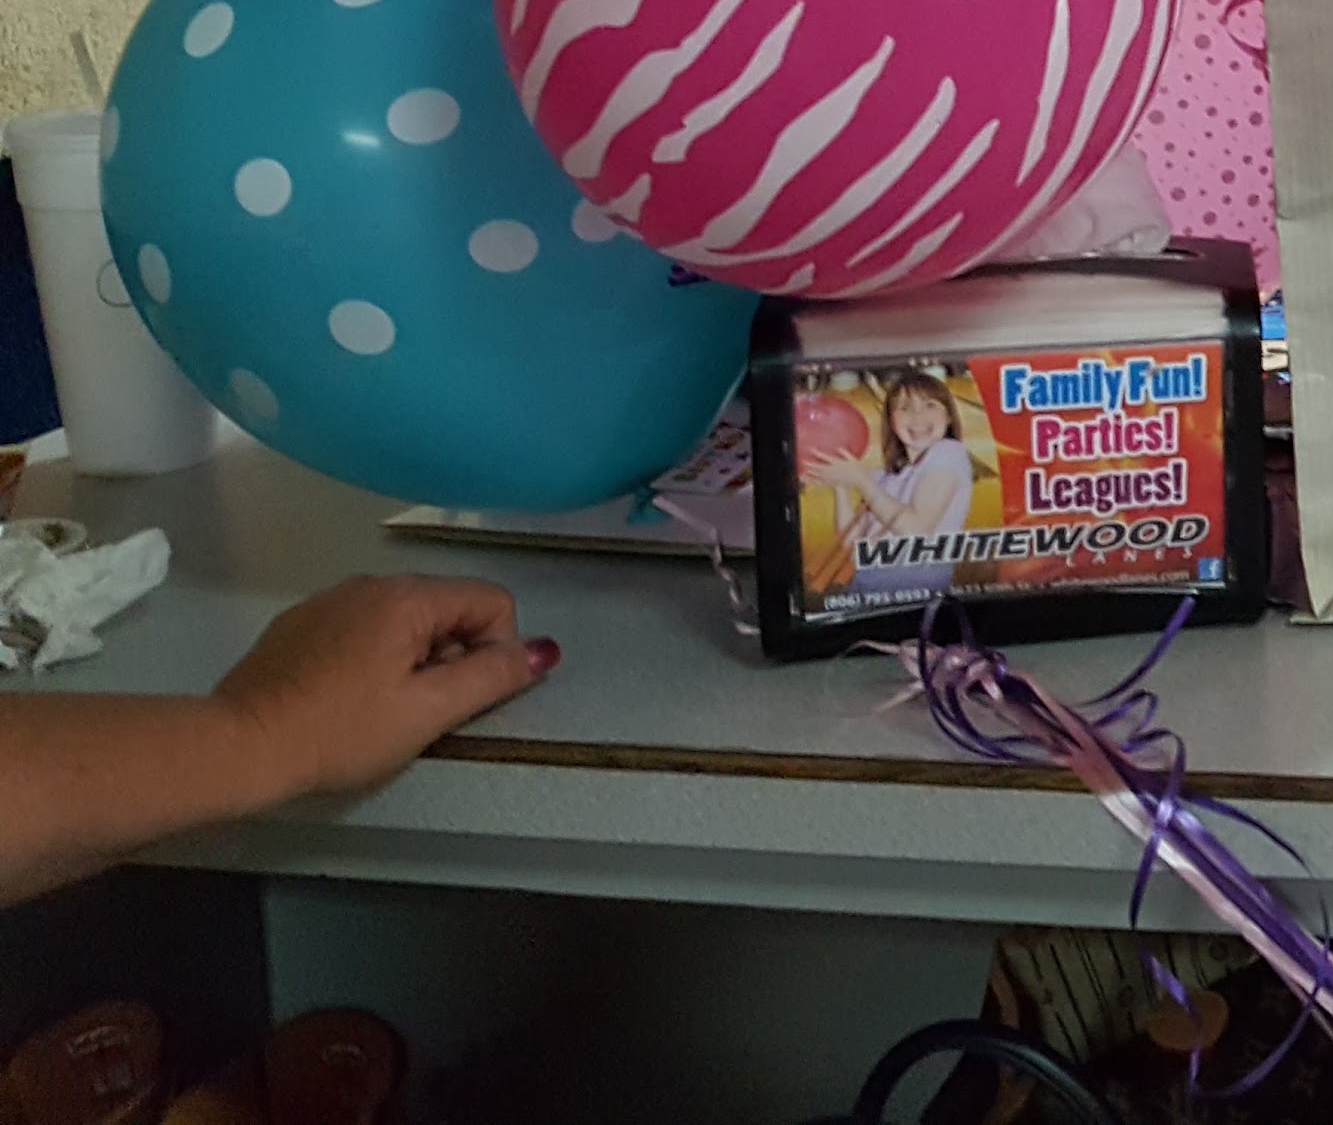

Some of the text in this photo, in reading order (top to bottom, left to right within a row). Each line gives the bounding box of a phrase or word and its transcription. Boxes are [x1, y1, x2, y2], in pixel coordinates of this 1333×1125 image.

[1002, 354, 1207, 412] Family Fun!
[1034, 411, 1175, 461] Parties!
[1028, 461, 1184, 514] Leagues!
[856, 517, 1209, 568] WHITEWOOD
